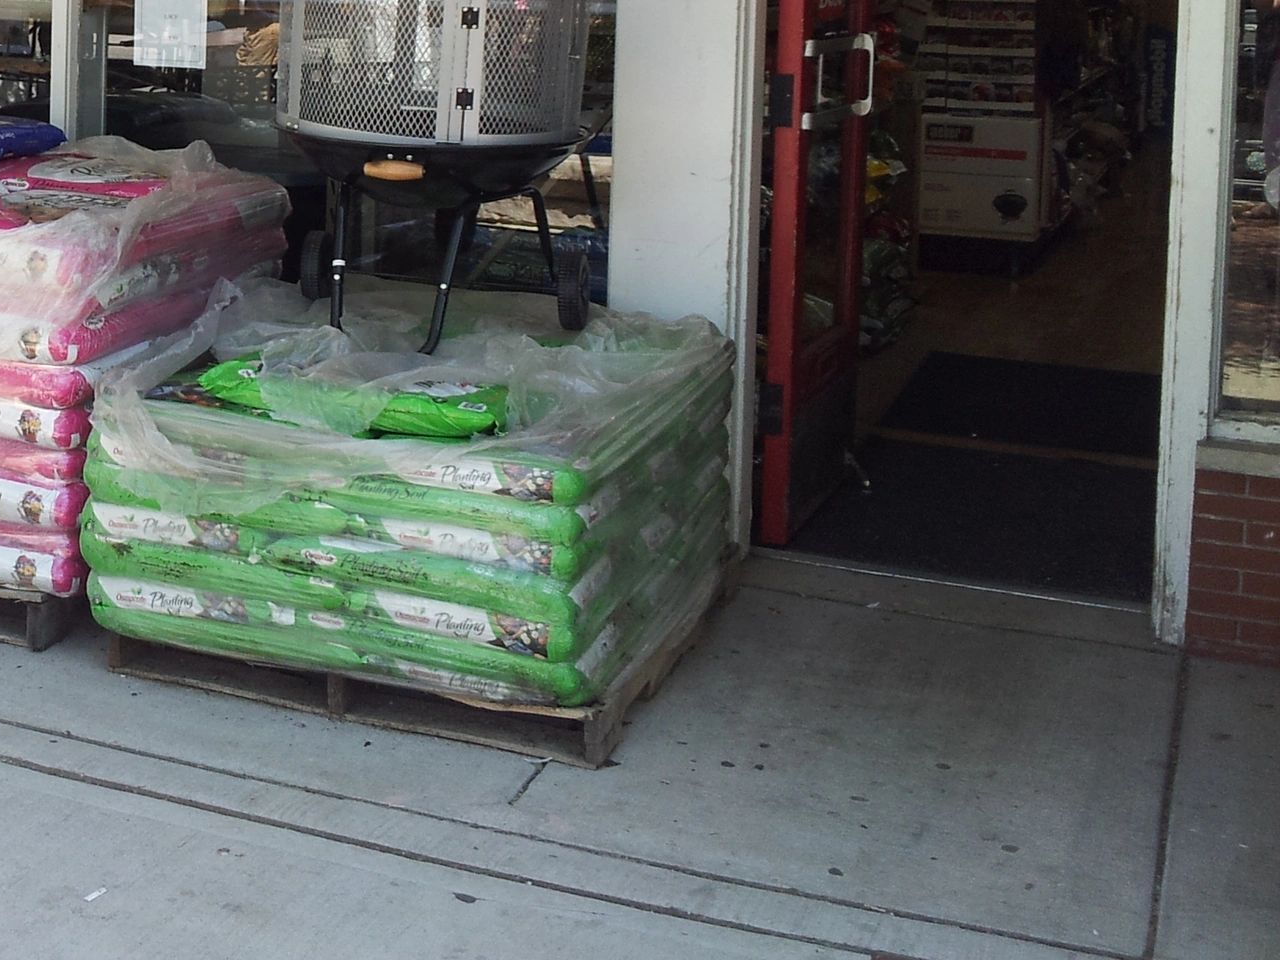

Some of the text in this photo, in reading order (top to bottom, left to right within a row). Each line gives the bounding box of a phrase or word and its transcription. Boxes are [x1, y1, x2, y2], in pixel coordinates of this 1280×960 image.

[441, 465, 492, 484] Planting
[150, 591, 194, 609] Planting
[434, 613, 486, 635] Planting
